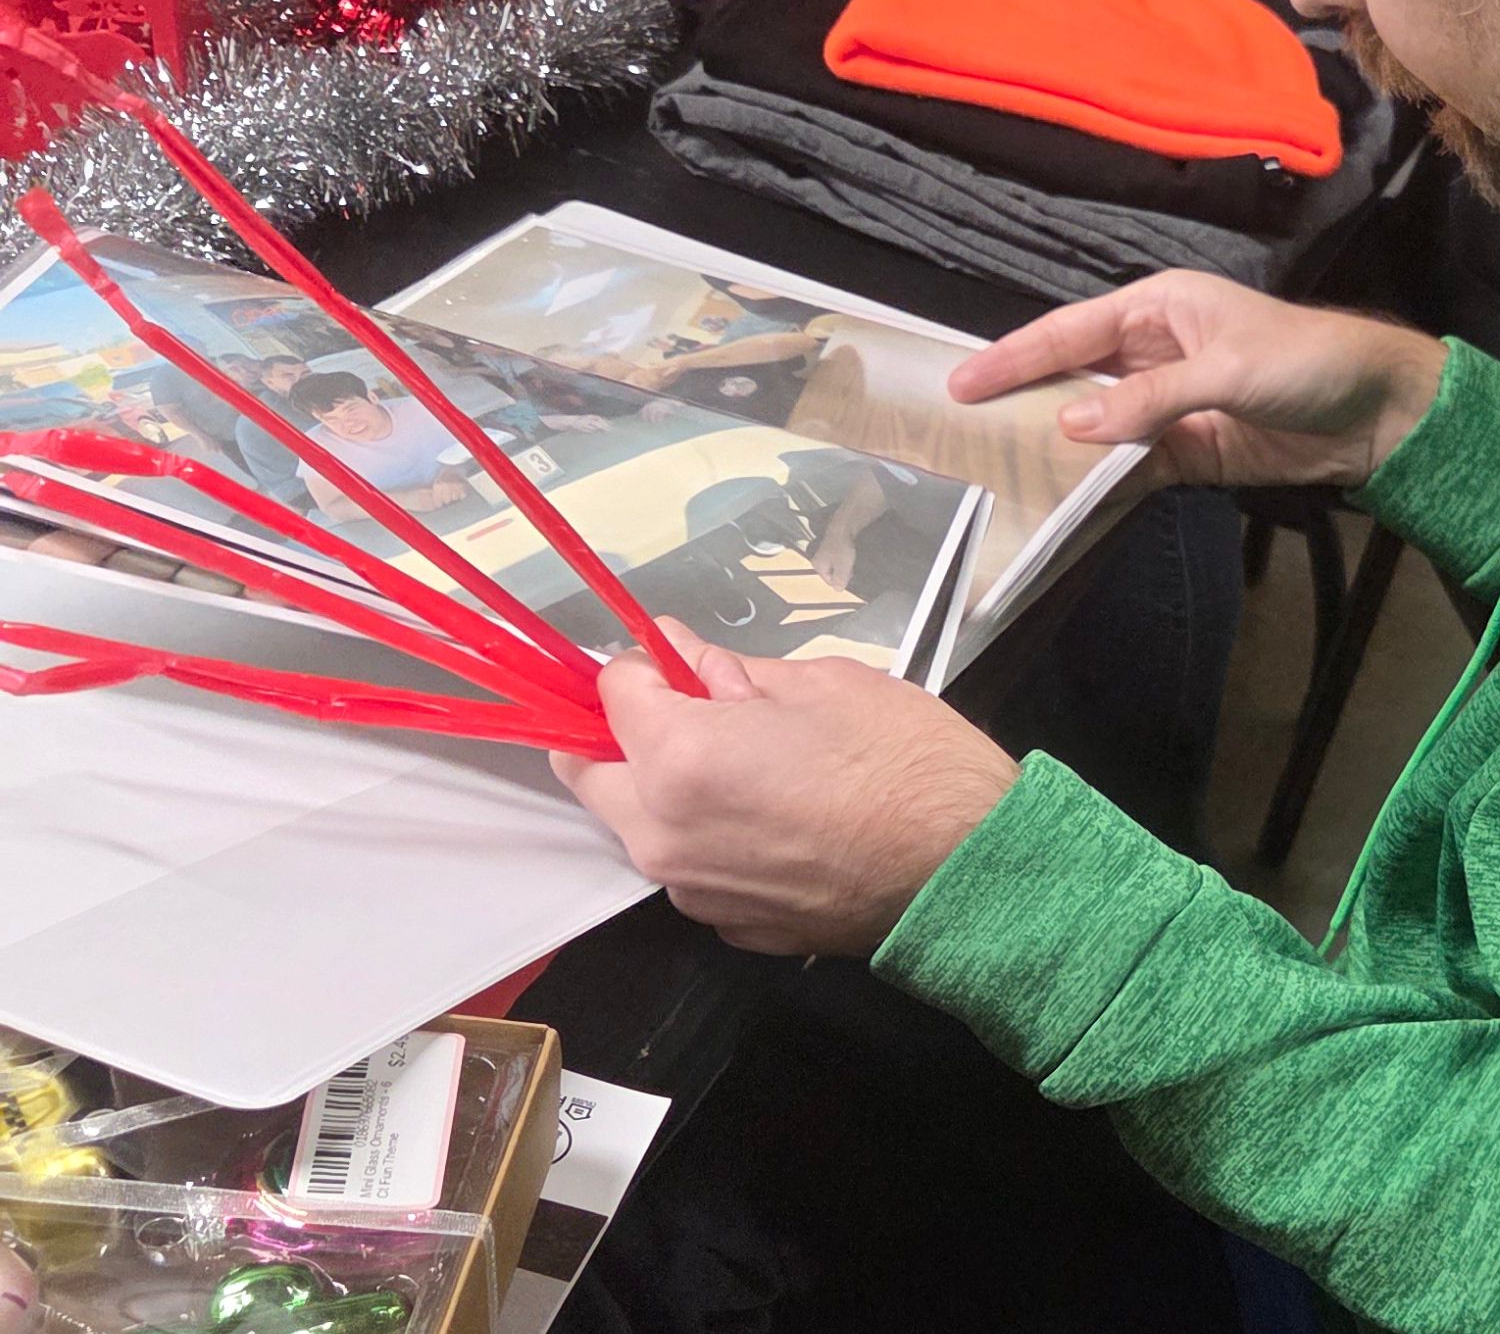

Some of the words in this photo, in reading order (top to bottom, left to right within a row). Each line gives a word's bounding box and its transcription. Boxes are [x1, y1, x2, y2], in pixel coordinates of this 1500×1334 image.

[530, 453, 551, 473] 3
[370, 1096, 390, 1147] Ornaments
[382, 1132, 399, 1165] Theme
[364, 1149, 380, 1176] Glass
[379, 1167, 393, 1185] Fun
[360, 1178, 374, 1198] Mini
